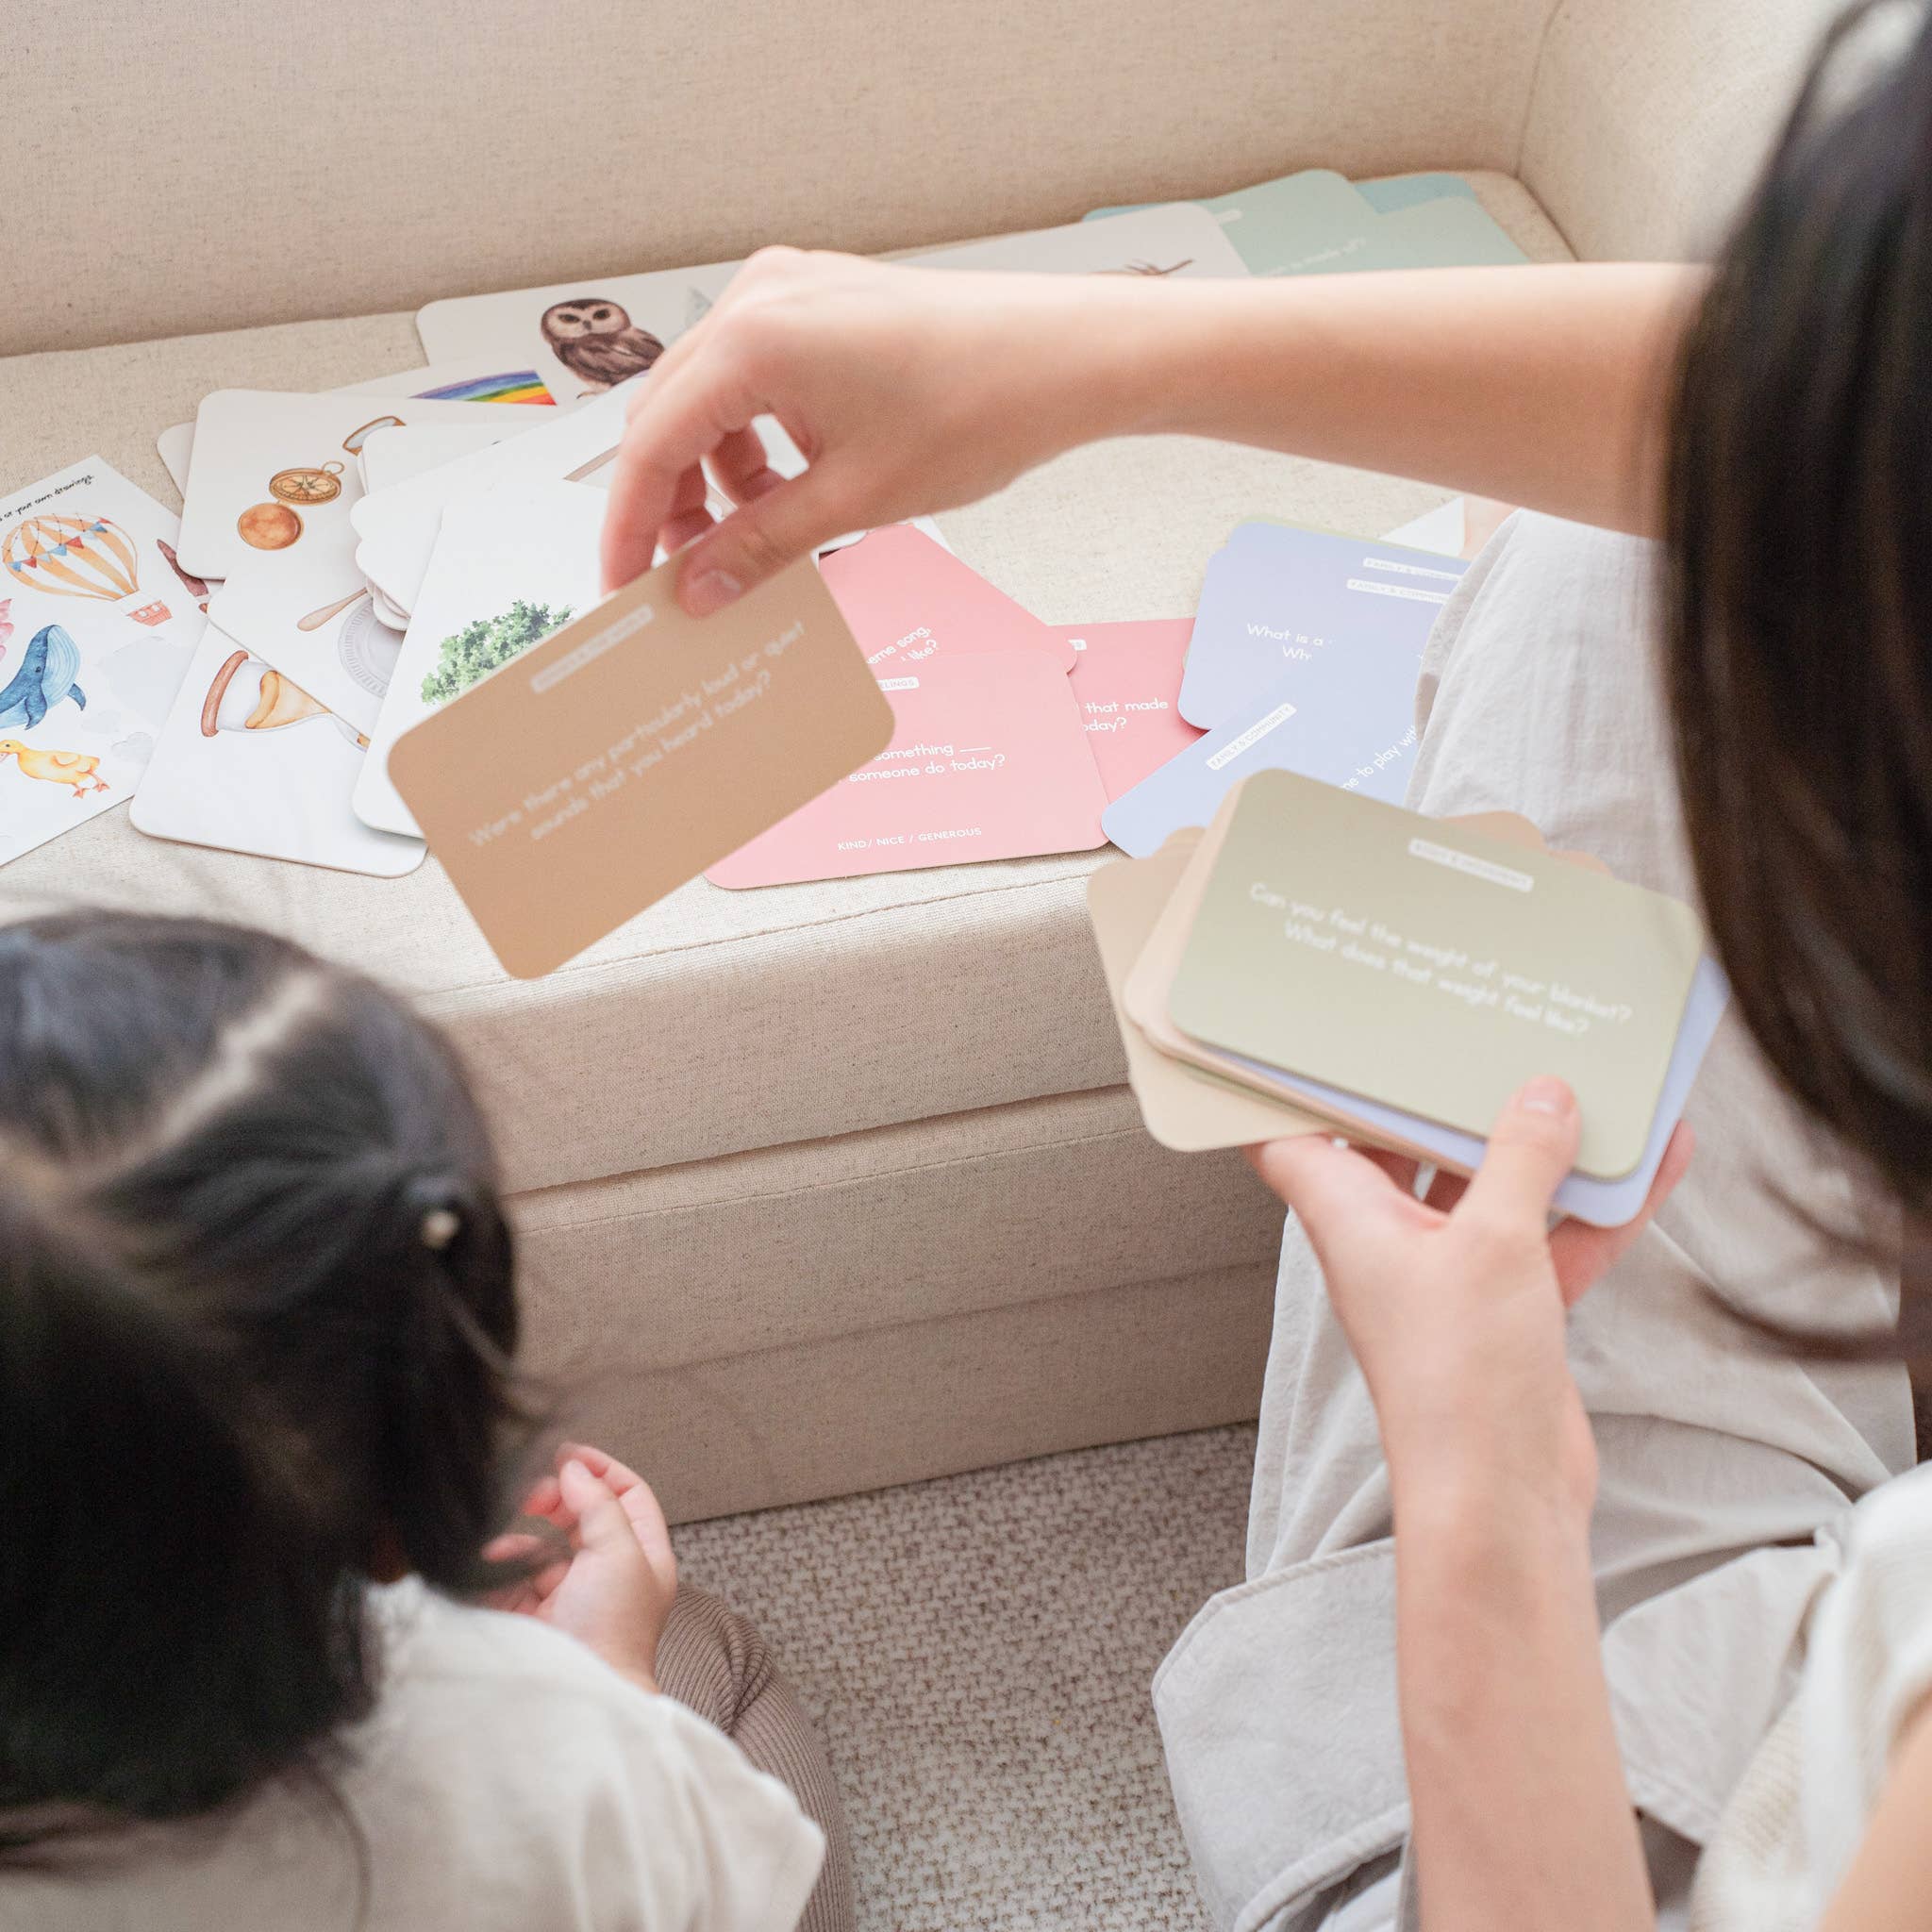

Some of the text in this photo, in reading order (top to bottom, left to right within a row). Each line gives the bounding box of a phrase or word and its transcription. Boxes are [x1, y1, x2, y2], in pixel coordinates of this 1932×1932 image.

[1247, 623, 1324, 647] What is a
[1282, 644, 1313, 660] Wh
[1085, 697, 1169, 714] that made
[874, 743, 954, 762] something
[1356, 766, 1374, 777] to
[1374, 745, 1402, 771] play
[849, 754, 1006, 783] someone do today?
[876, 835, 906, 846] NICE
[919, 826, 982, 841] GENEROUS
[1250, 882, 1287, 908] Can
